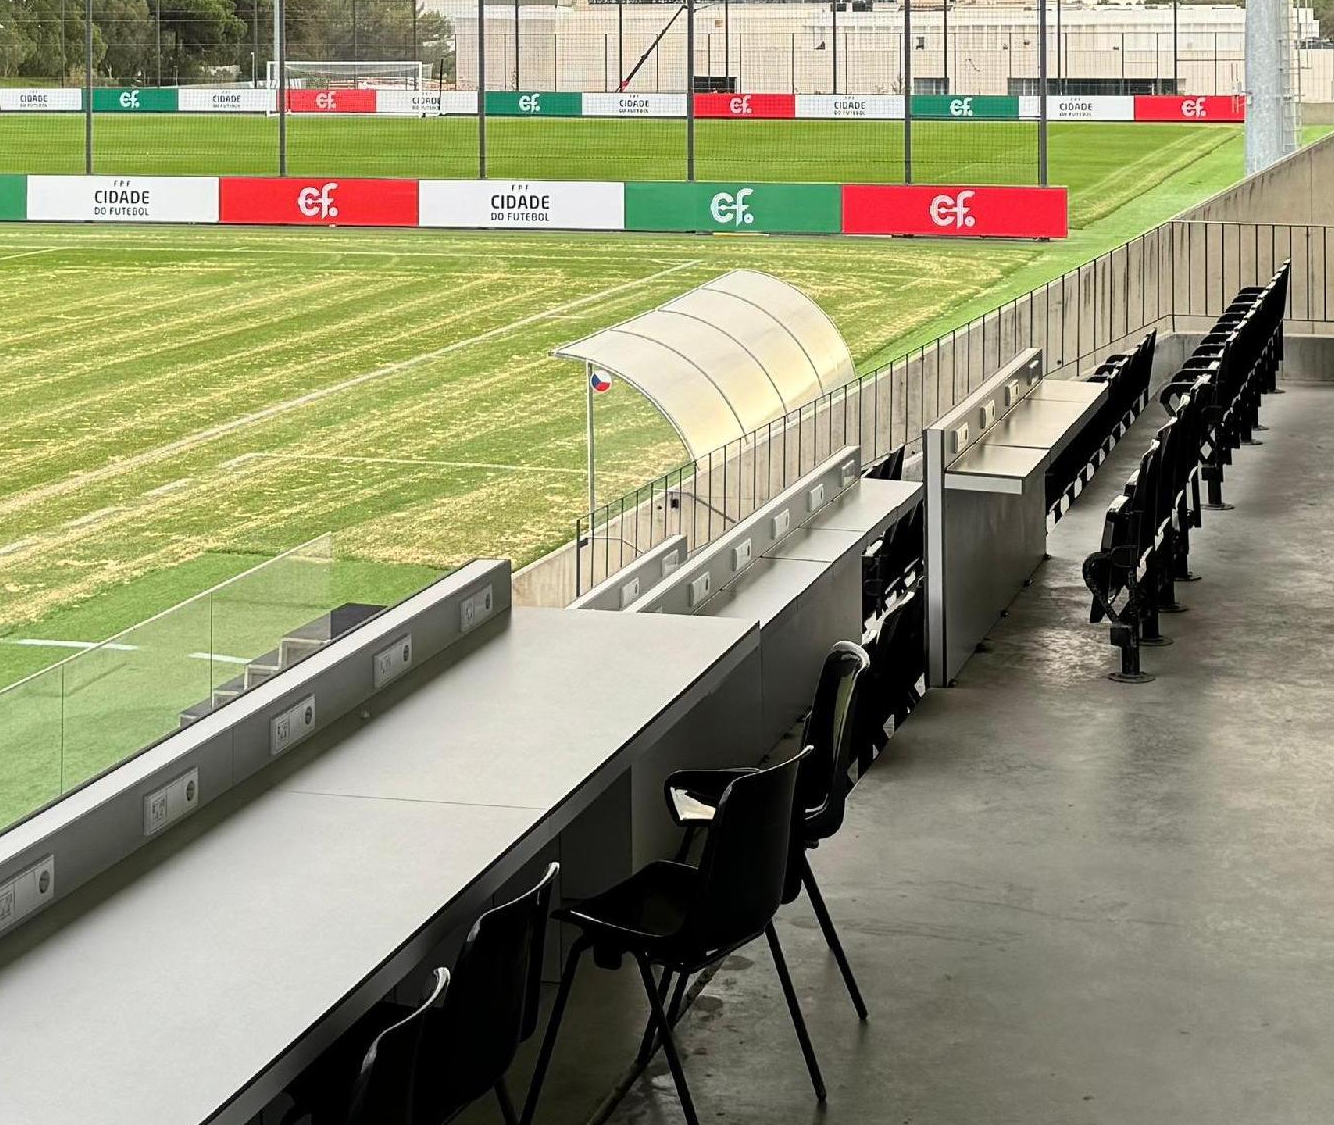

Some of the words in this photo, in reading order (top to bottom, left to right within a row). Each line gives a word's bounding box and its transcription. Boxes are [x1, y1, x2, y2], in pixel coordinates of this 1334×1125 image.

[95, 190, 150, 204] CIDADE
[490, 195, 550, 210] CIDADE
[94, 206, 107, 216] DO
[109, 206, 149, 216] FUTEBOL
[490, 212, 505, 221] DO
[507, 212, 550, 222] FUTEBOL
